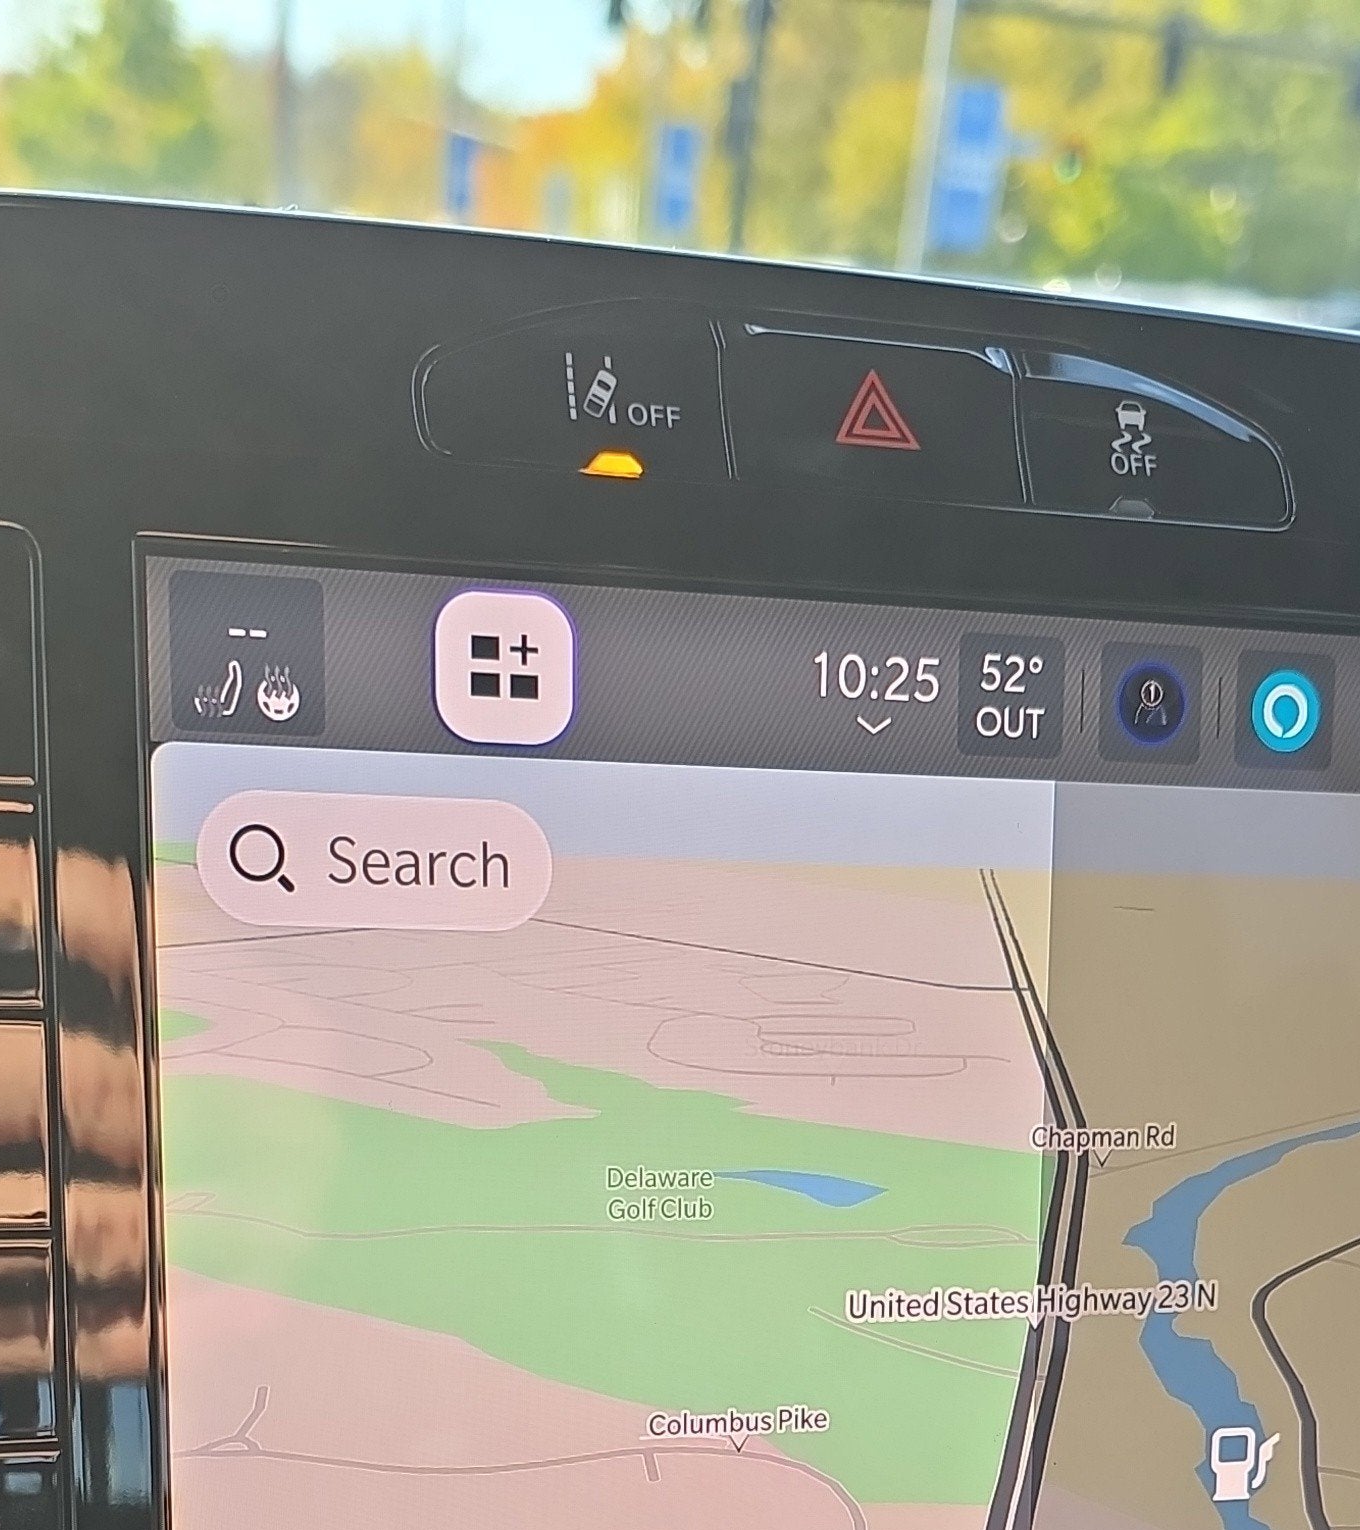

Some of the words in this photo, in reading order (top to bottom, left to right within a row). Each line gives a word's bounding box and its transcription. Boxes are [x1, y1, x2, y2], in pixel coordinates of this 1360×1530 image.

[628, 402, 681, 428] OFF
[1111, 452, 1157, 477] OFF
[813, 651, 941, 704] 10:25
[980, 653, 1045, 694] 52°
[975, 705, 1045, 740] OUT
[327, 835, 511, 889] Search
[1032, 1125, 1140, 1154] Chapman
[1145, 1123, 1175, 1149] Rd
[606, 1166, 713, 1191] Delaware
[608, 1196, 657, 1221] Golf
[661, 1196, 713, 1220] Club
[848, 1290, 939, 1320] United
[943, 1289, 1029, 1317] States
[1036, 1285, 1154, 1319] Highway
[1157, 1284, 1192, 1311] 23
[1196, 1283, 1217, 1309] N
[648, 1411, 772, 1439] Columbus
[779, 1408, 829, 1435] Pike
